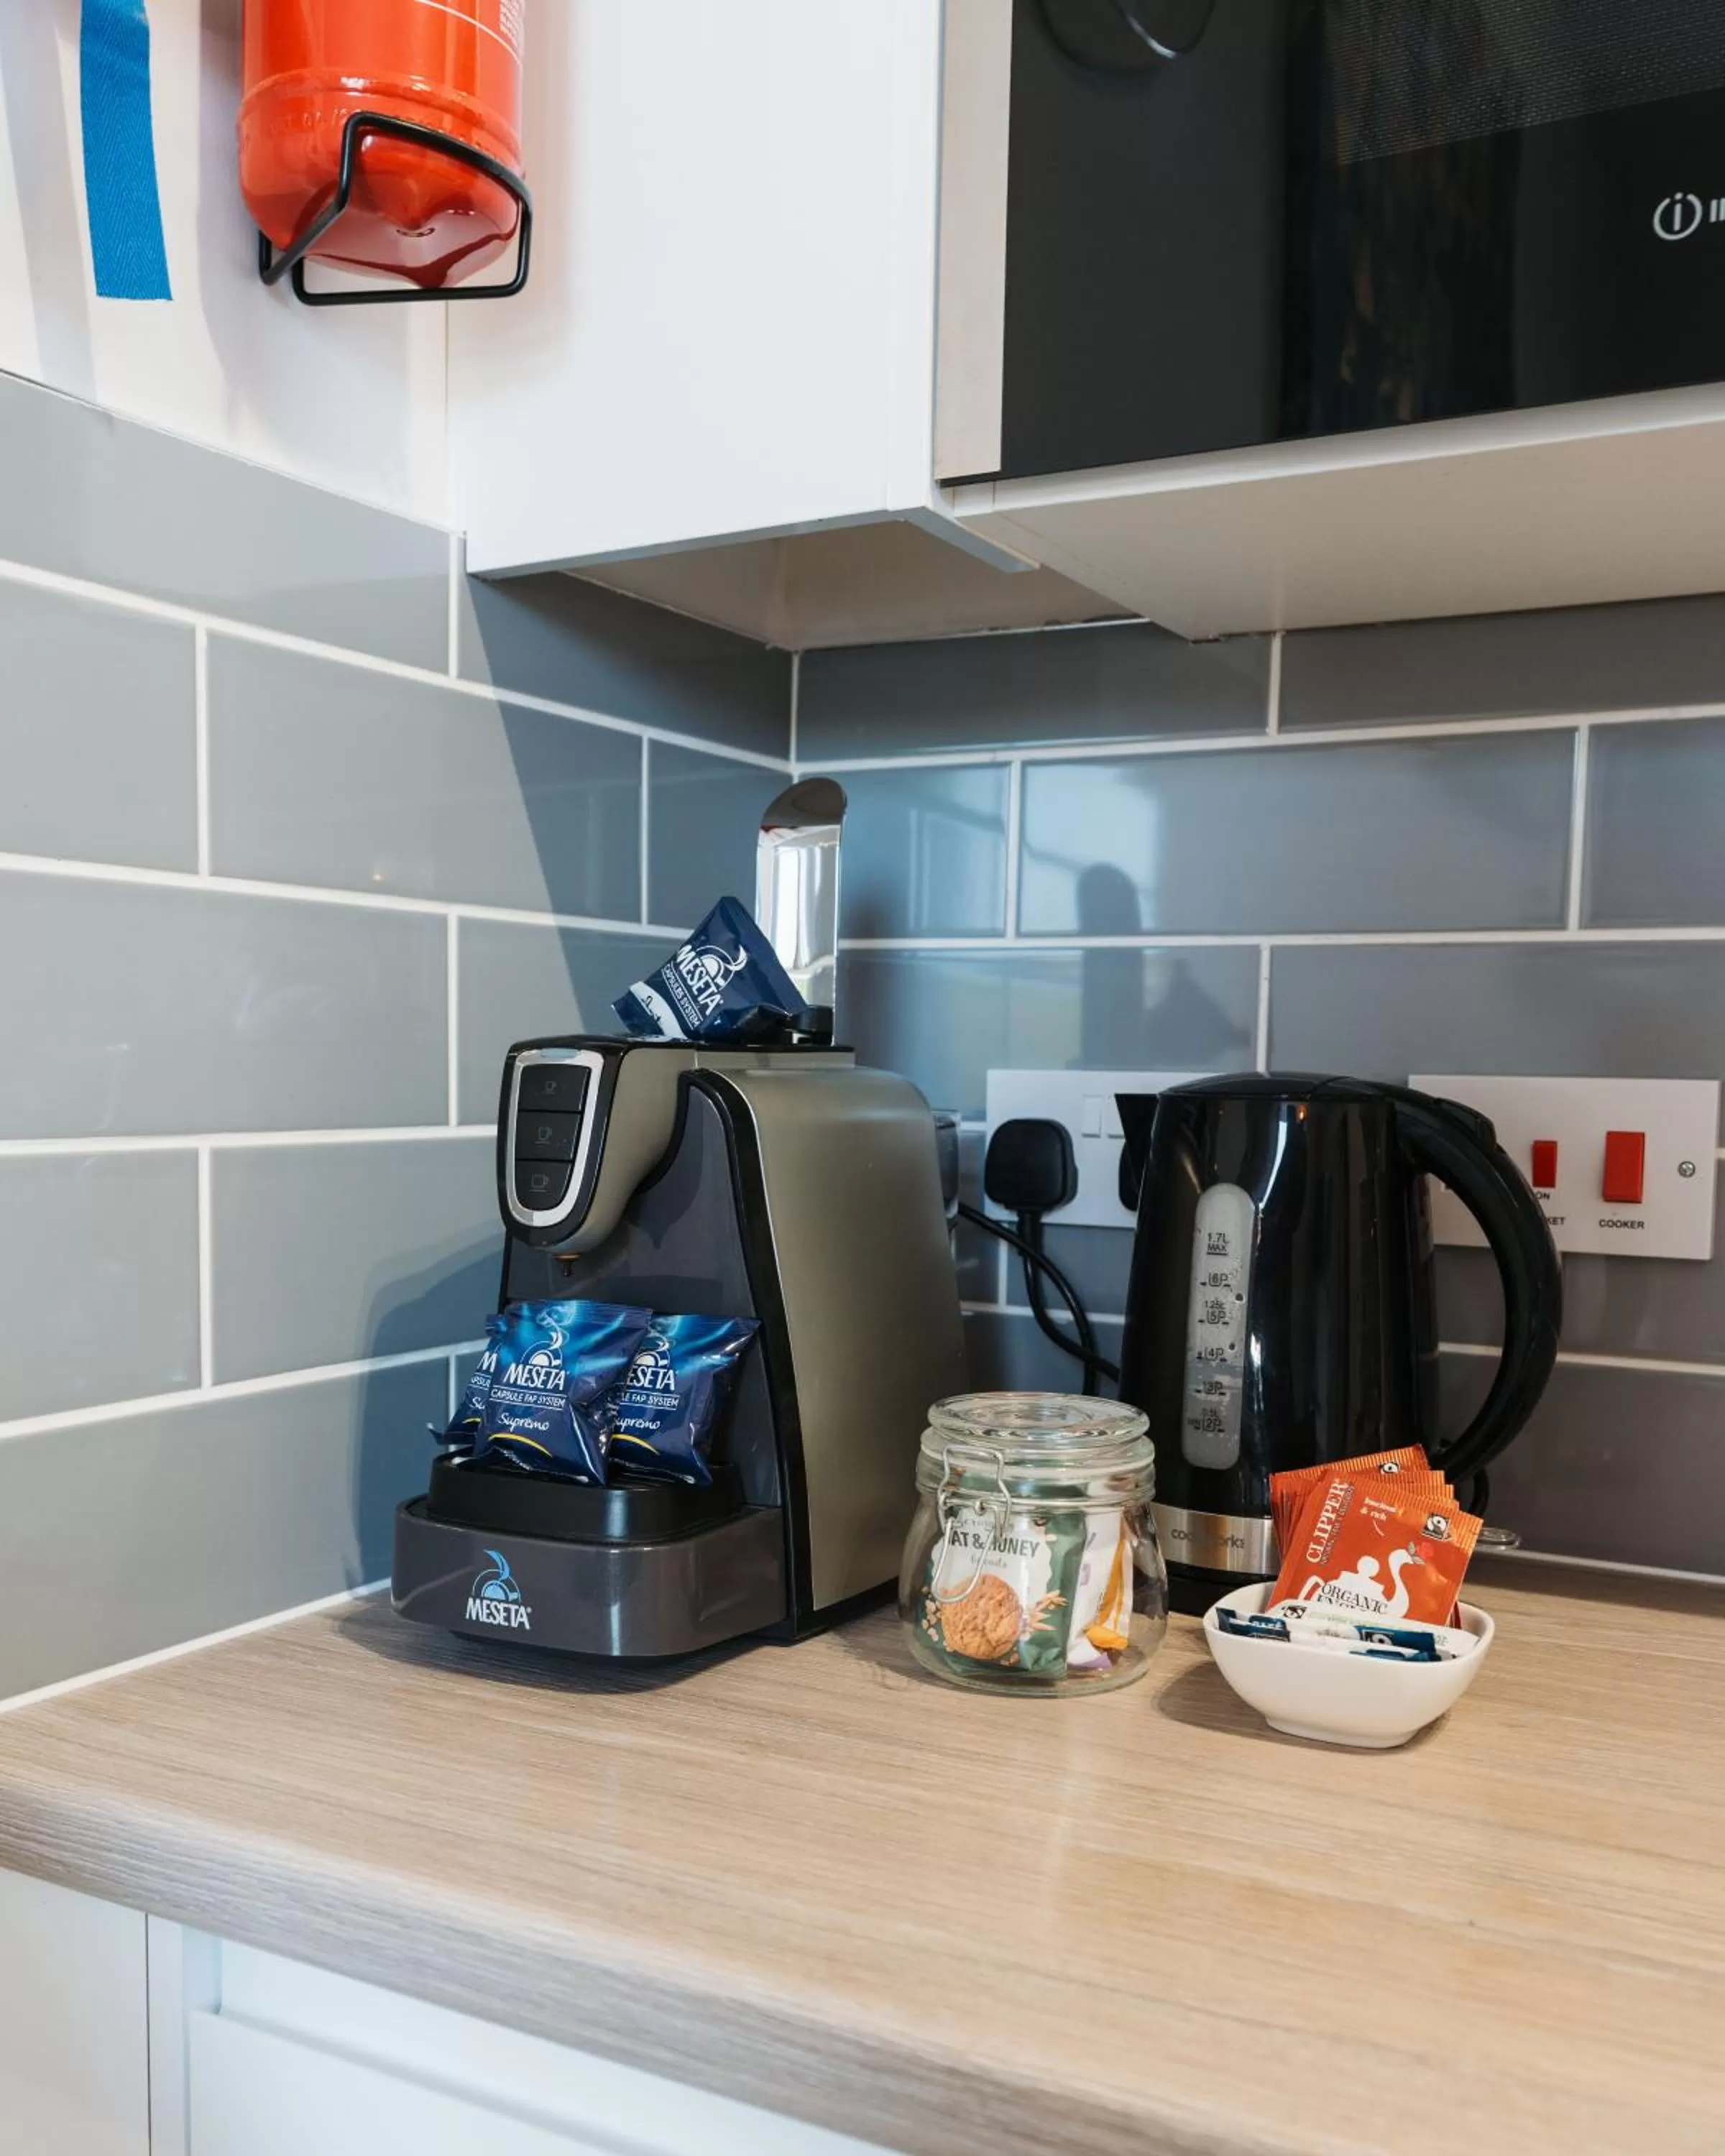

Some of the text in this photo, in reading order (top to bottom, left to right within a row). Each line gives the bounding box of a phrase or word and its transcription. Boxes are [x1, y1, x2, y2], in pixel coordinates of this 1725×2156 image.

[677, 944, 722, 1015] MESETA
[678, 997, 702, 1027] SYSTEM
[1598, 1219, 1644, 1230] COOKER
[1208, 1232, 1229, 1243] 1.7L
[1208, 1243, 1227, 1252] MAX
[503, 1363, 566, 1391] MESETA
[626, 1365, 675, 1391] ESETA
[491, 1388, 523, 1402] CAPSULE
[538, 1395, 566, 1407] SYSTEM
[632, 1393, 646, 1402] FAP
[648, 1395, 678, 1407] SYSTEM
[615, 1417, 661, 1432] upremo
[1306, 1478, 1348, 1564] CLIPPER
[951, 1530, 970, 1547] AT
[972, 1533, 985, 1549] &
[1322, 1583, 1387, 1615] ORGANIC
[466, 1597, 530, 1631] MESETA
